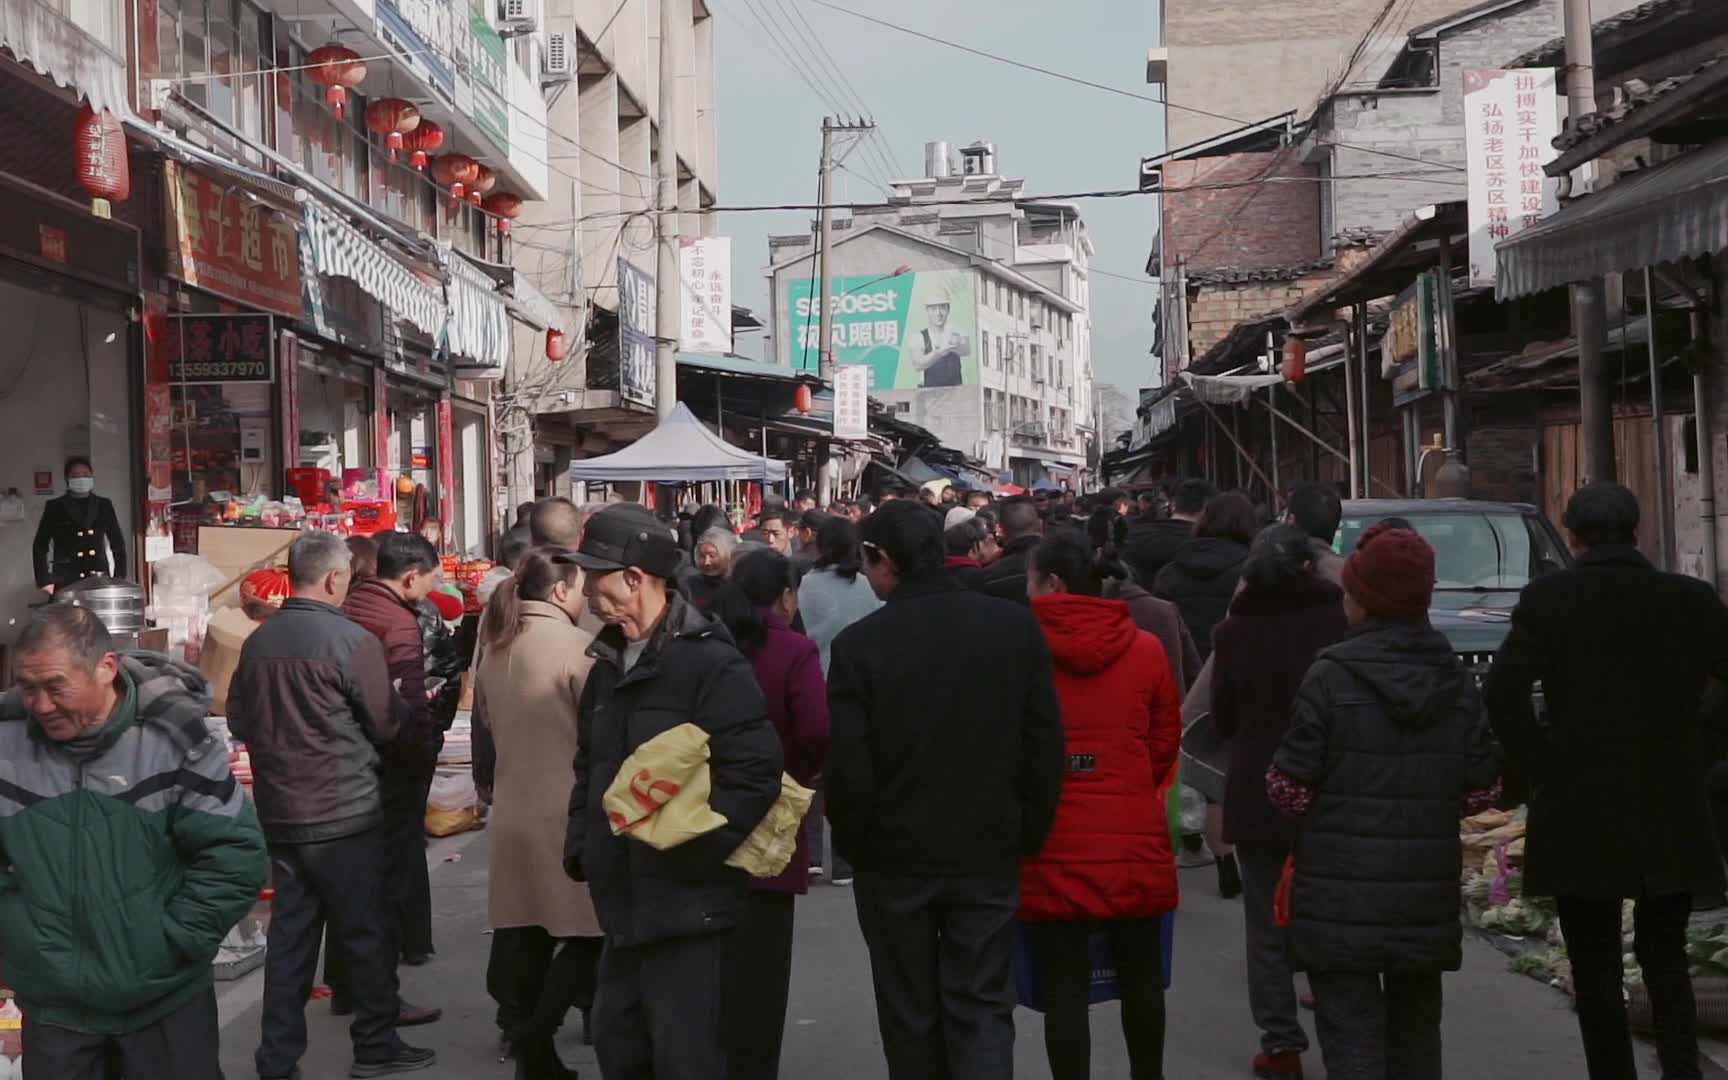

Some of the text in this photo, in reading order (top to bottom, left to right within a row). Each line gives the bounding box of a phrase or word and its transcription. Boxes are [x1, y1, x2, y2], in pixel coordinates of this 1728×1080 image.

[1482, 103, 1509, 239] 弘扬老区苏区精神
[168, 362, 265, 377] 13559337970
